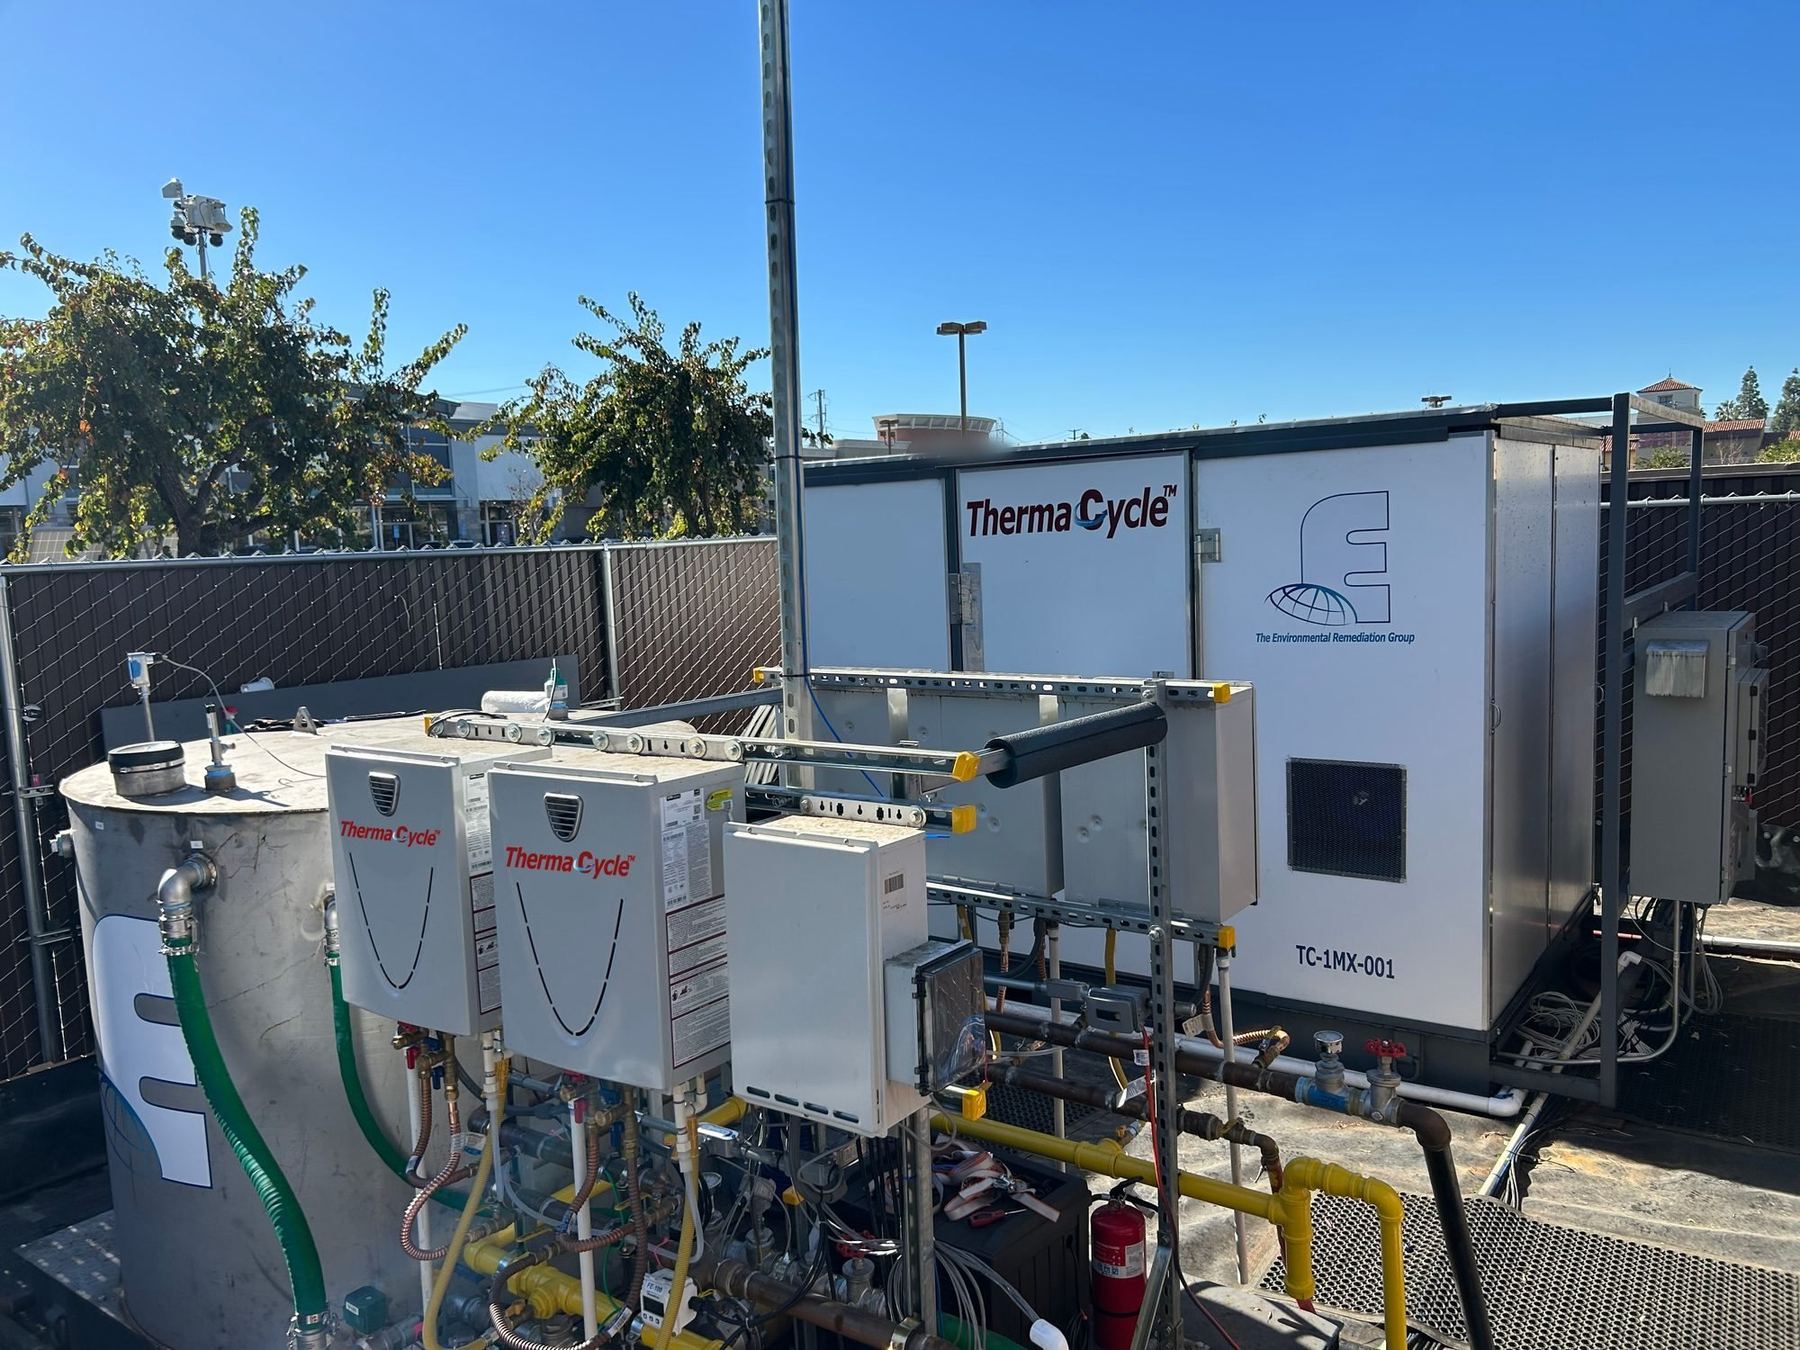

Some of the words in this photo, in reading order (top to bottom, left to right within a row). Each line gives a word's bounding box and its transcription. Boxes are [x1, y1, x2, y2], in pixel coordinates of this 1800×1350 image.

[1256, 633, 1271, 643] The
[1272, 632, 1331, 643] Environmental
[1333, 632, 1386, 643] Remediation
[1388, 632, 1415, 645] Group
[1295, 944, 1395, 980] TC-1MX-001
